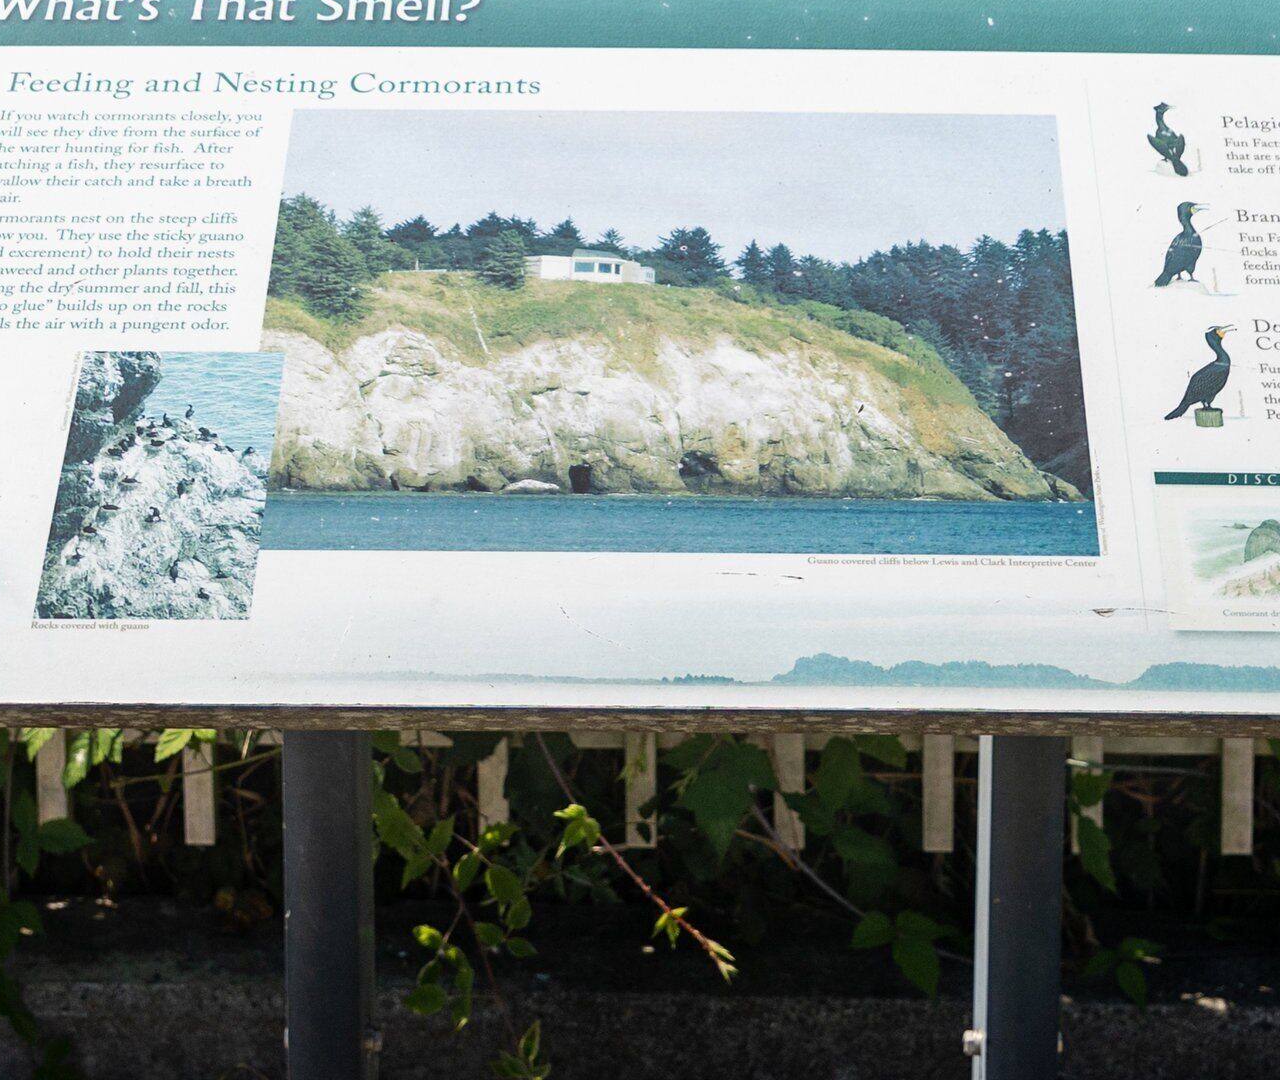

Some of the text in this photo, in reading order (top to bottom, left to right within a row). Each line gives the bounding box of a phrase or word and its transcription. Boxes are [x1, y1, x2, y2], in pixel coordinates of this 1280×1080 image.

[7, 72, 541, 98] Feeding and Nesting Cormorants
[0, 110, 262, 124] If you watch cormorants closely, you
[27, 129, 48, 137] see
[54, 126, 82, 139] they
[89, 126, 118, 137] dive
[124, 126, 157, 137] from
[163, 126, 185, 137] the
[190, 126, 240, 137] surface
[246, 126, 263, 137] of
[1225, 138, 1248, 147] Fun
[20, 143, 59, 154] water
[65, 143, 122, 156] hunting
[128, 143, 148, 154] for
[154, 143, 183, 154] fish.
[193, 143, 233, 154] After
[1227, 152, 1250, 160] that
[56, 162, 62, 170] a
[68, 159, 97, 172] fish,
[104, 159, 135, 172] they
[140, 159, 204, 170] resurface
[210, 160, 224, 170] to
[71, 213, 101, 223] nest
[106, 215, 124, 223] on
[131, 212, 153, 223] the
[159, 212, 196, 226] steep
[202, 212, 238, 223] cliffs
[16, 233, 47, 243] you.
[57, 230, 95, 243] They
[99, 233, 121, 241] use
[127, 230, 149, 241] the
[154, 230, 195, 243] sticky
[198, 233, 244, 243] guano
[9, 247, 92, 260] excrement)
[98, 249, 112, 258] to
[118, 247, 151, 258] hold
[158, 247, 192, 258] their
[197, 249, 234, 258] nests
[1241, 247, 1277, 257] flocks
[807, 556, 1097, 569] Guano covered cliffs below Lewis and Clark Interpretive Center
[31, 621, 150, 632] Rocks covered with guano
